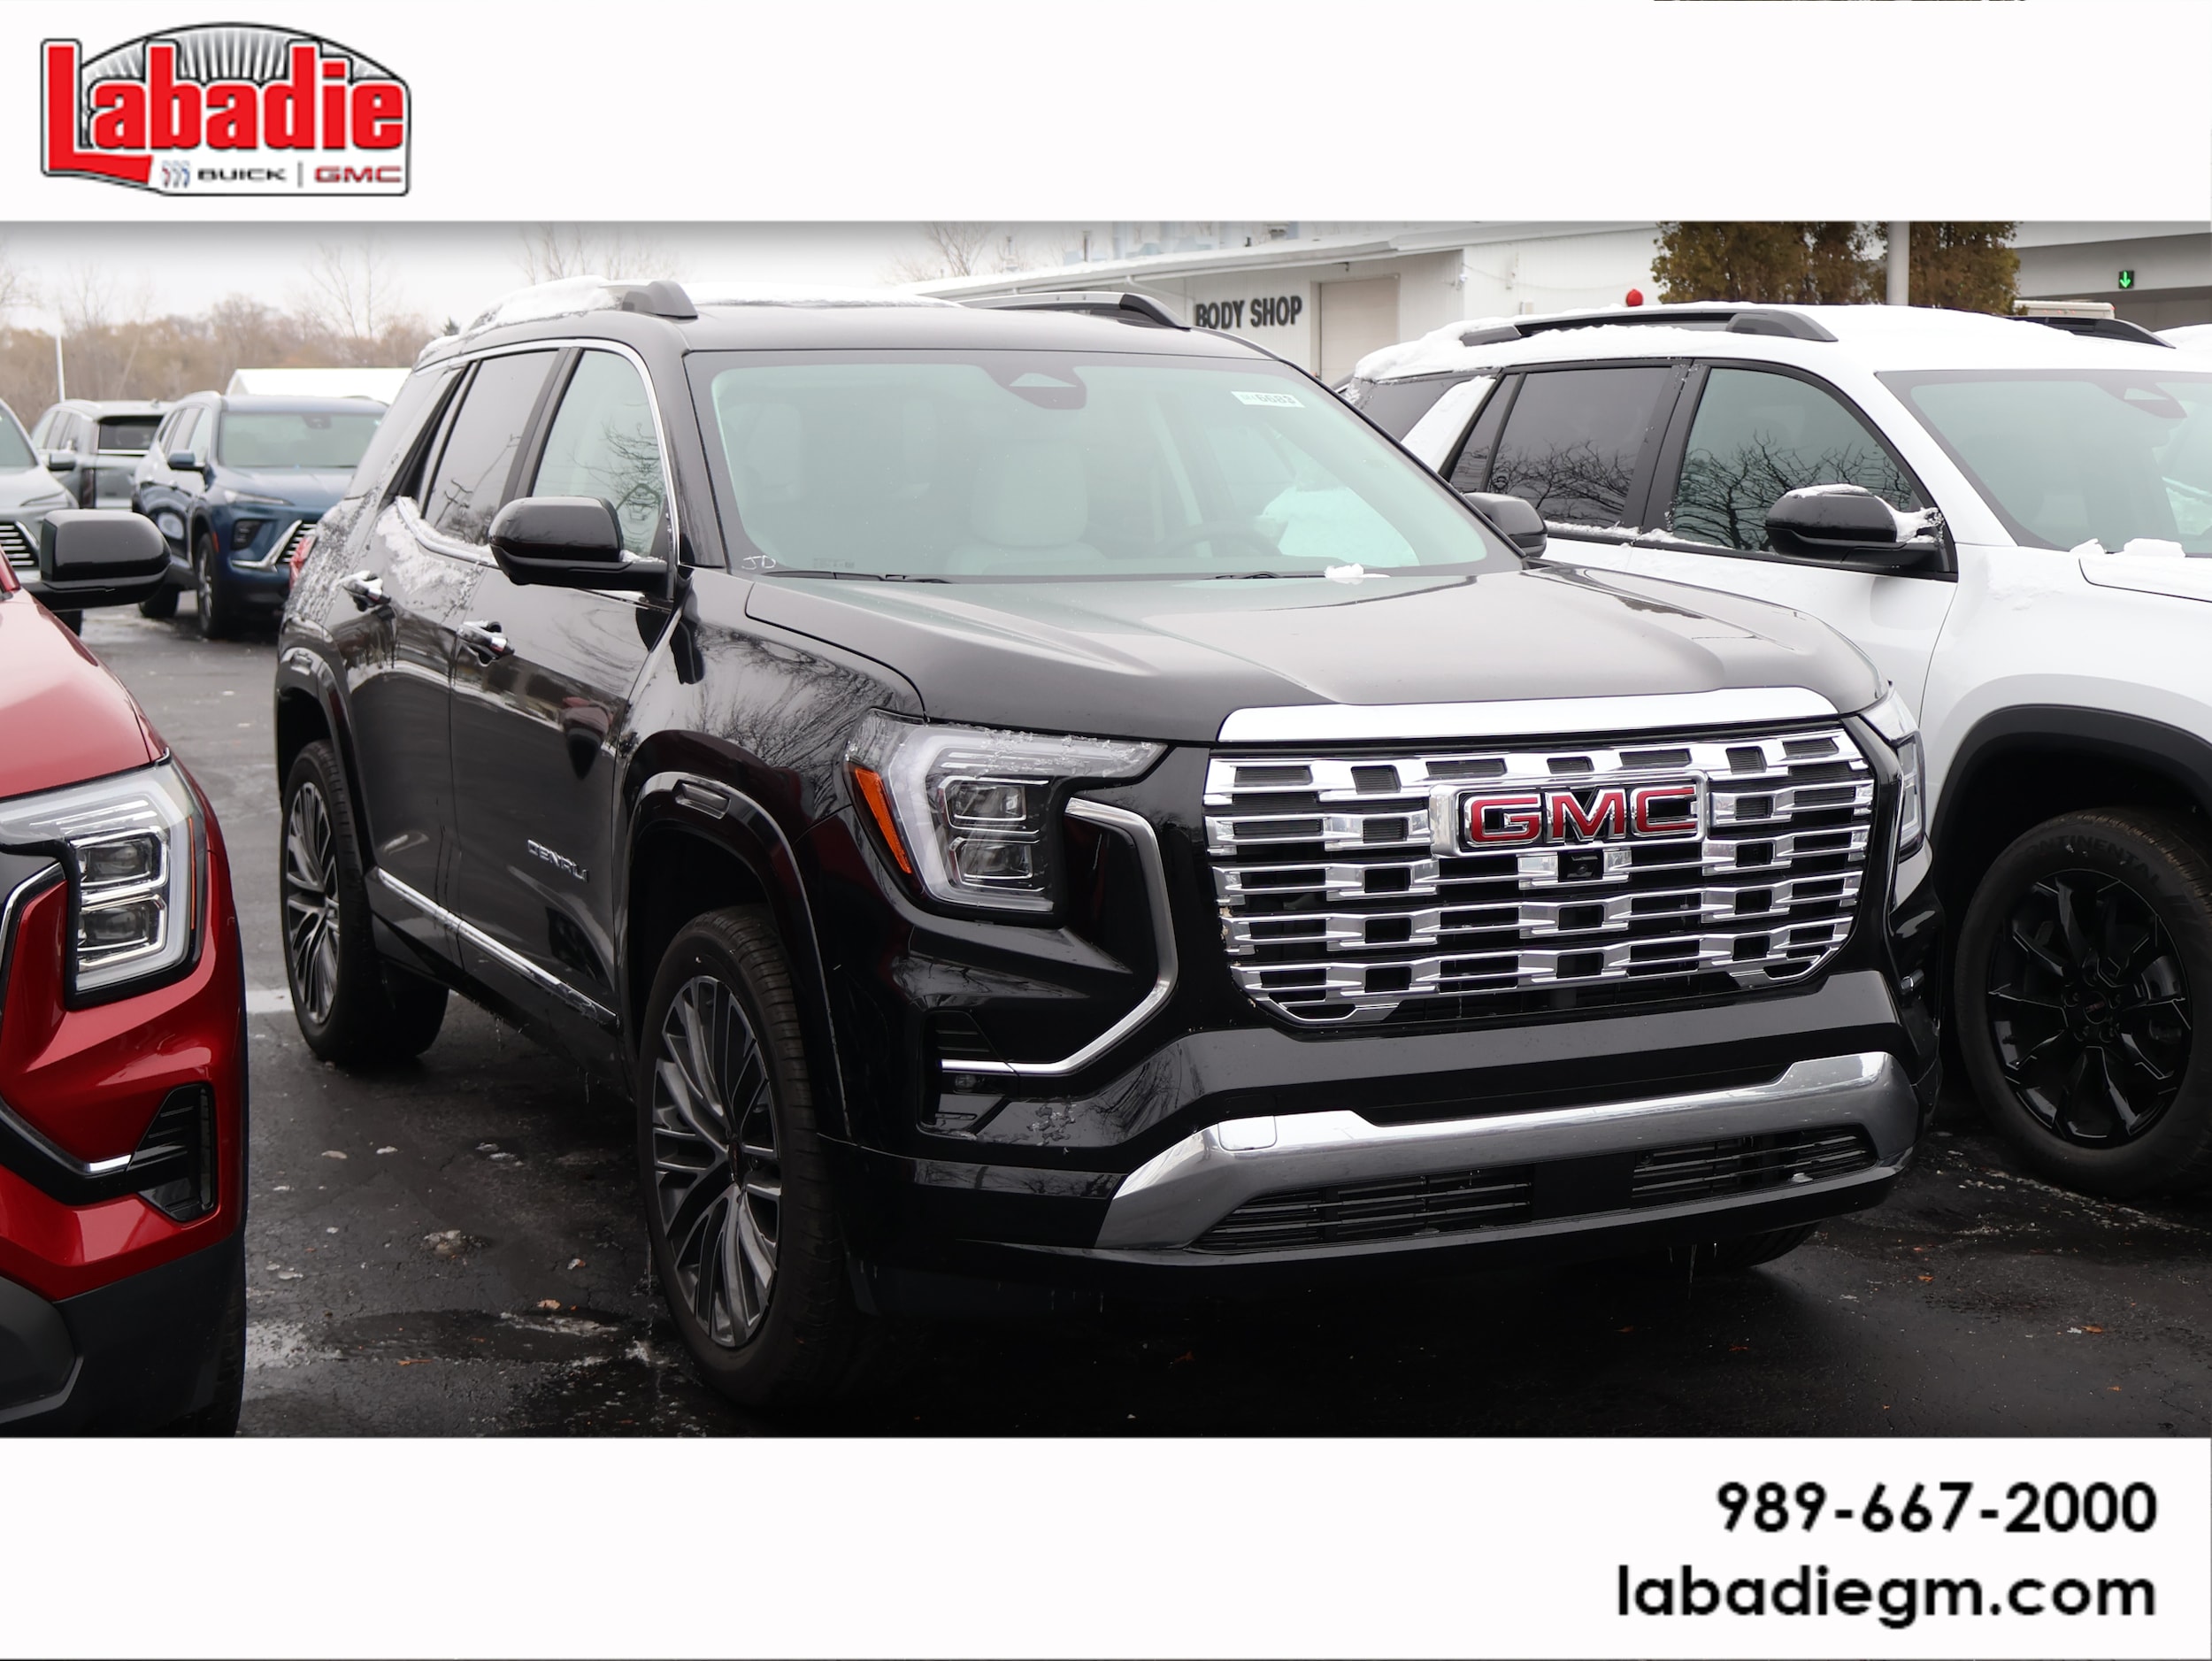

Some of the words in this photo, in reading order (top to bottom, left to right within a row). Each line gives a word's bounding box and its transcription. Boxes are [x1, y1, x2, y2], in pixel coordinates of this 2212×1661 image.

[1195, 300, 1245, 329] BODY
[1250, 296, 1302, 327] SHOP
[1463, 783, 1698, 849] GMC
